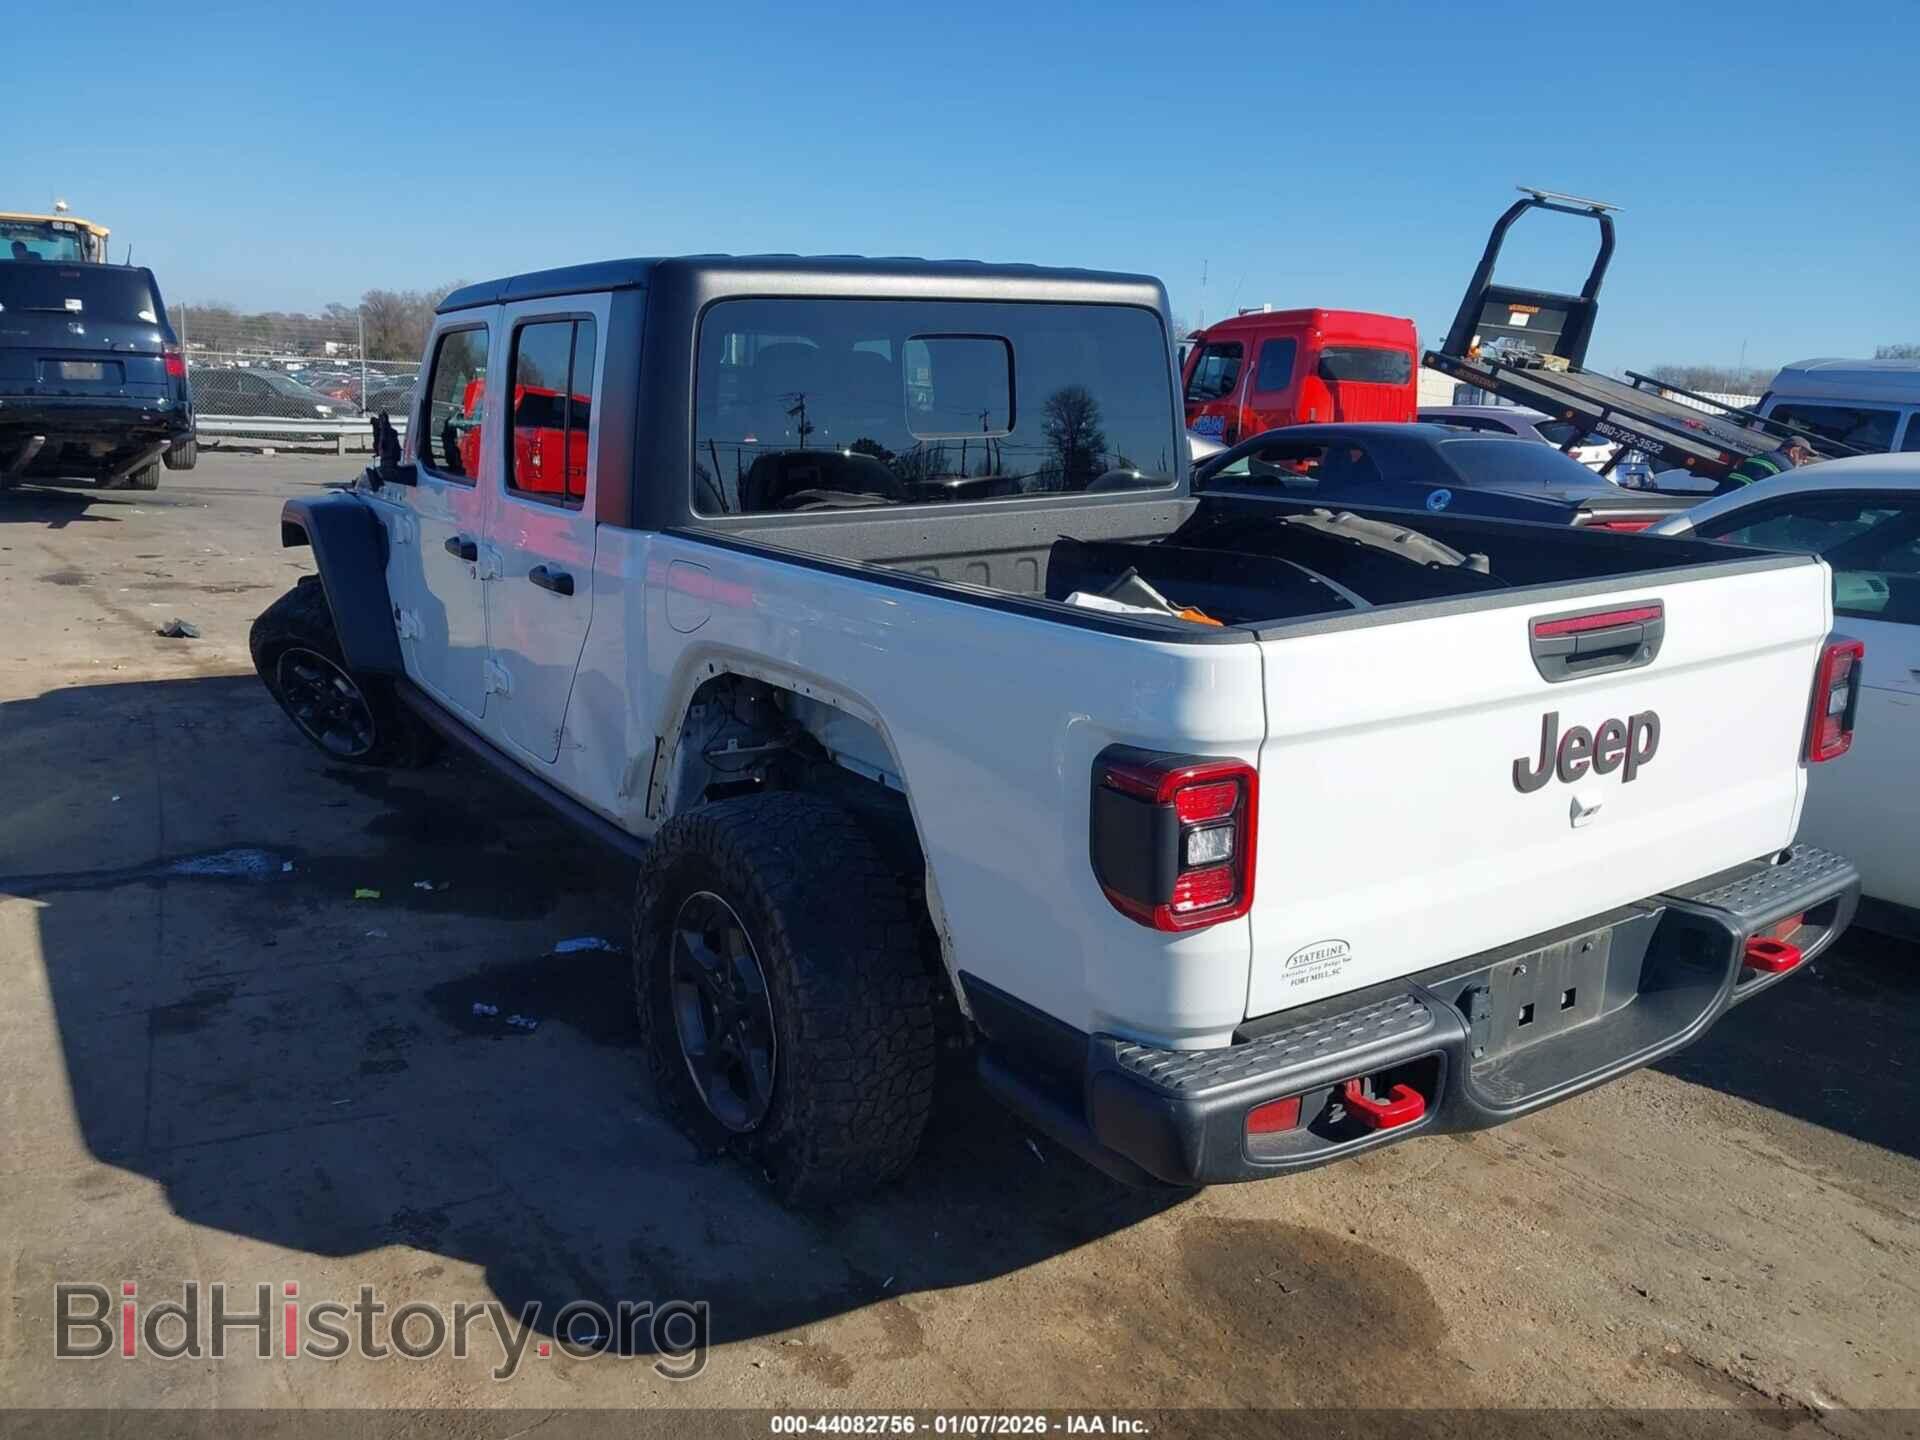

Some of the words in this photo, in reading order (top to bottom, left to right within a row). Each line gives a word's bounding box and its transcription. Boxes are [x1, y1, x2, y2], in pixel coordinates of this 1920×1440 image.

[1595, 422, 1664, 455] 980-722-3522
[1512, 710, 1661, 794] Jeep
[1293, 944, 1344, 966] STATELINE
[1290, 976, 1309, 987] FORT
